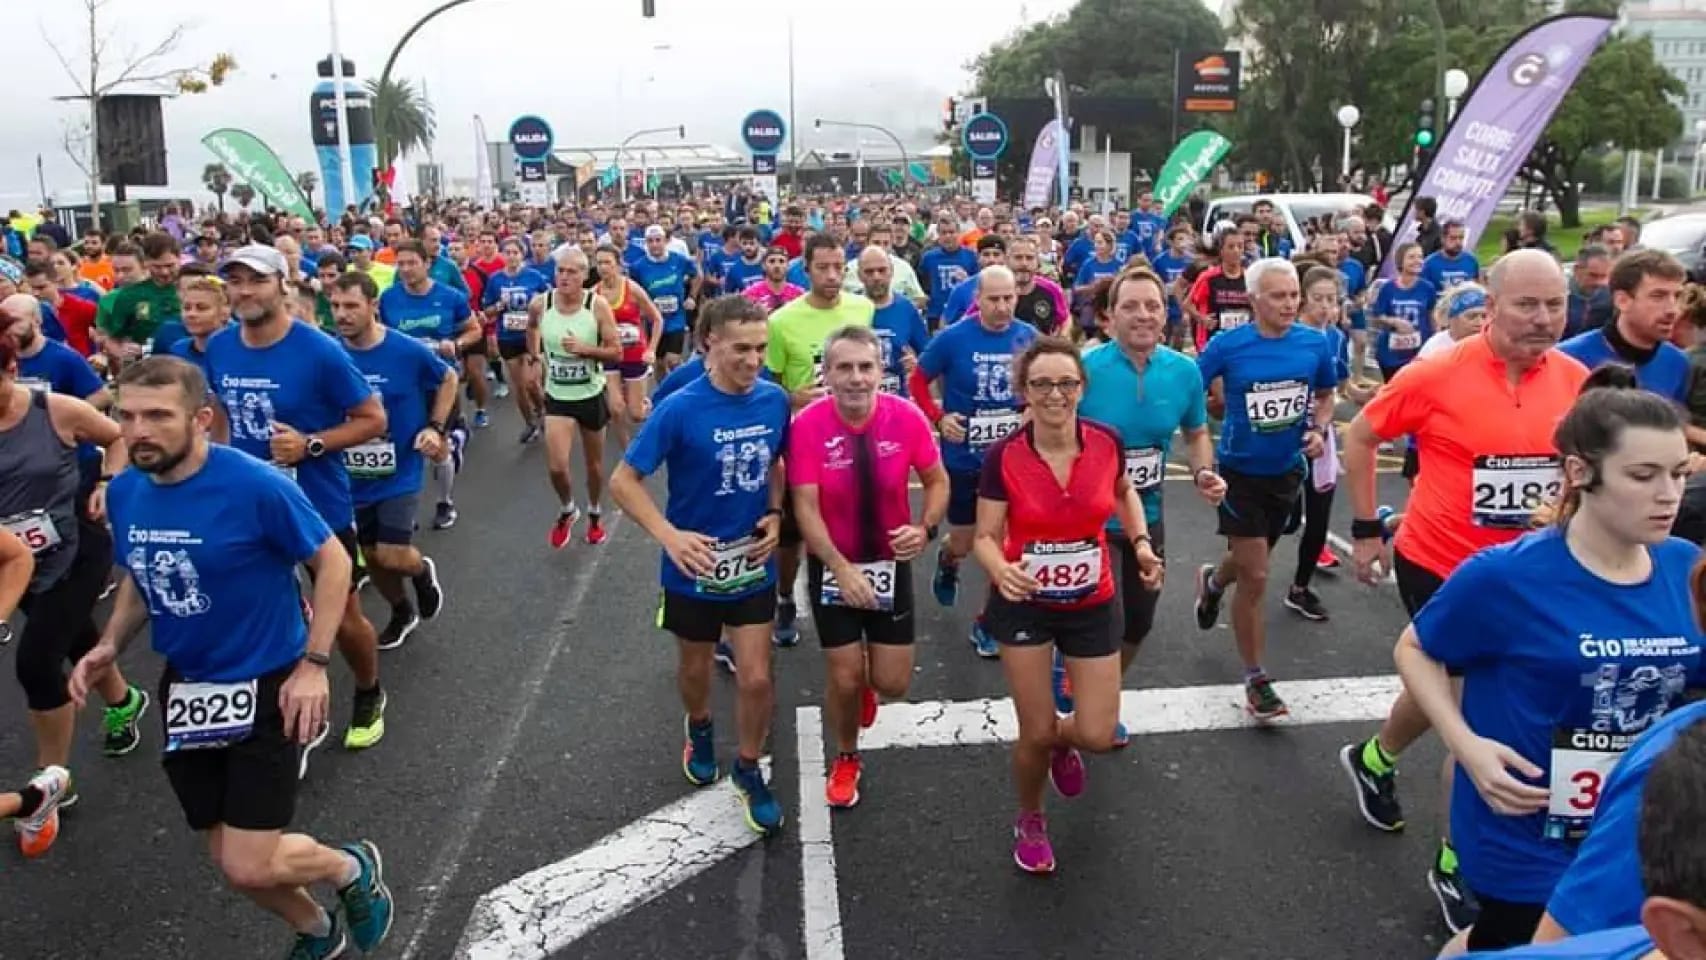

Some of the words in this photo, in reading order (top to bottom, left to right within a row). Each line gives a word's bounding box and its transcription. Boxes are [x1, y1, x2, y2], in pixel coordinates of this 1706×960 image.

[514, 132, 548, 144] SALIDA
[747, 127, 782, 137] SALIDA
[968, 131, 1002, 141] SALIDA
[1465, 121, 1516, 153] CORRE
[1250, 395, 1305, 421] 1676
[344, 451, 394, 468] 1932
[1127, 464, 1158, 486] 34
[1035, 562, 1090, 588] 482
[169, 689, 253, 728] 2629
[1569, 769, 1602, 811] 3
